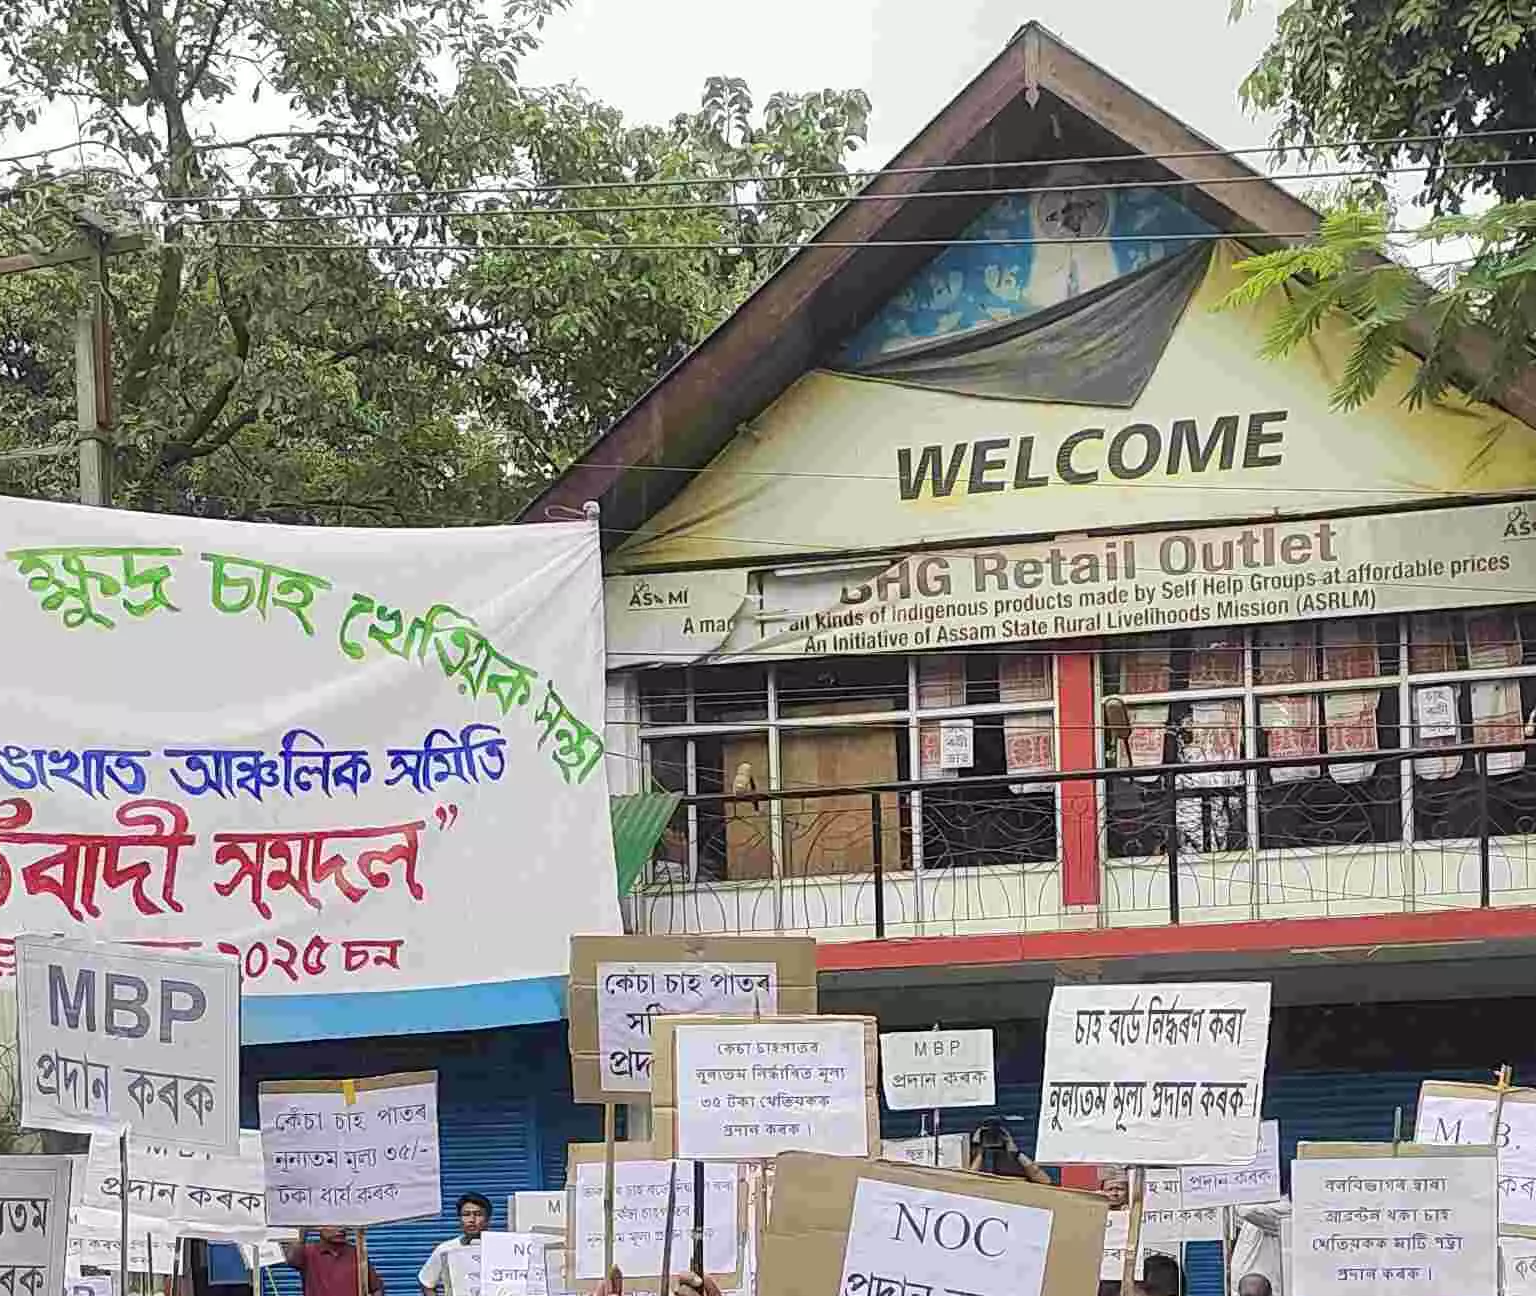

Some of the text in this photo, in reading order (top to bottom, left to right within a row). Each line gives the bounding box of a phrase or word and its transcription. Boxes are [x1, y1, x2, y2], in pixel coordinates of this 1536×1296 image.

[896, 409, 1289, 502] WELCOME
[974, 522, 1338, 594] Retail Outlet
[201, 552, 333, 637] চাহ
[804, 587, 1377, 654] An Initiative of Assam State Rural Livelihoods Mission (ASRLM)
[816, 610, 864, 632] kinds
[870, 608, 886, 625] of
[891, 599, 989, 628] Indigenous
[994, 594, 1074, 619] products
[1080, 588, 1131, 608] made
[1135, 584, 1156, 606] by
[1162, 579, 1197, 600] Self
[1203, 576, 1244, 599] Help
[1250, 572, 1317, 595] Groups
[1321, 570, 1342, 585] at
[1347, 560, 1444, 584] affordable
[1449, 553, 1510, 578] prices
[384, 724, 508, 794] সমিতি
[49, 964, 207, 1044] MBP
[664, 970, 703, 998] চাহ
[1075, 1009, 1105, 1047] চাহ
[1208, 1008, 1247, 1048] কৰা
[35, 1052, 216, 1127] প্ৰদান কৰক
[376, 1104, 427, 1126] পাতৰ
[1151, 1081, 1197, 1119] প্ৰদান
[1199, 1081, 1248, 1119] কৰক
[186, 1185, 264, 1212] কৰক
[892, 1202, 1010, 1257] NOC
